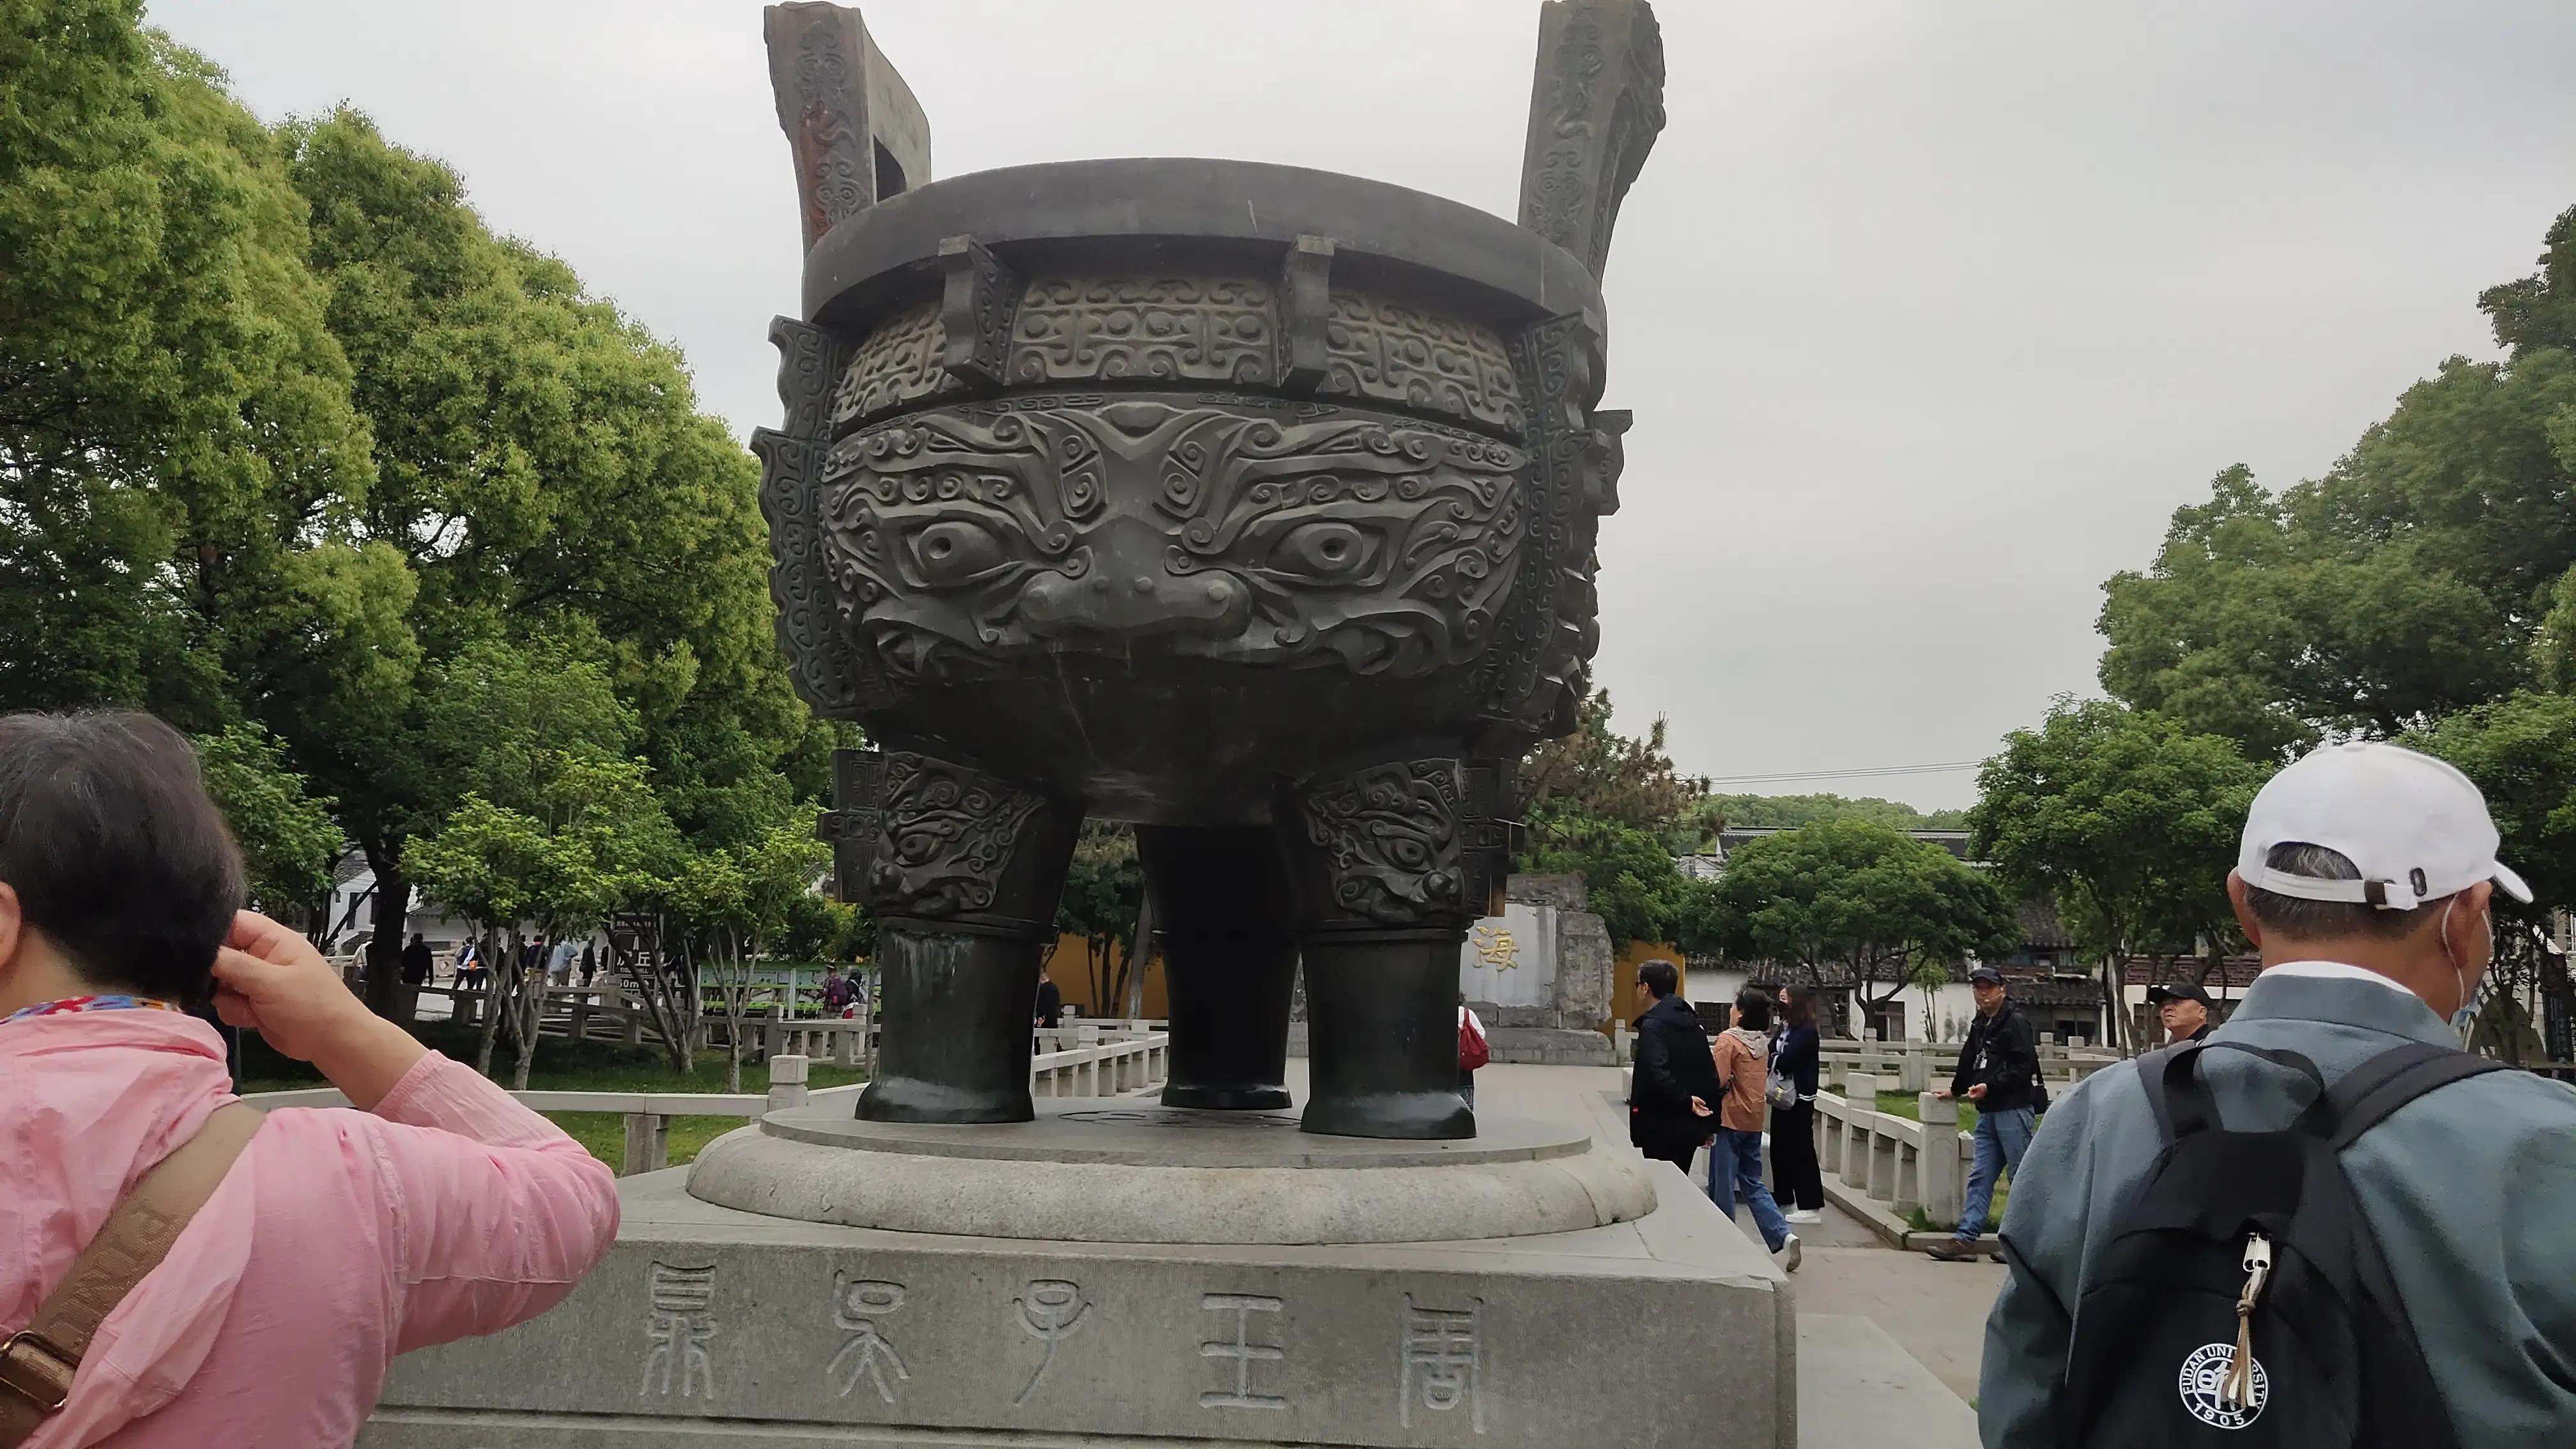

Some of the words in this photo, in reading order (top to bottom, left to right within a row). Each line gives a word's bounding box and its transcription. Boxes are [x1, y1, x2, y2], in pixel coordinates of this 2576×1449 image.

[1472, 926, 1520, 971] 海
[2183, 1351, 2205, 1395] FUDAN
[2206, 1347, 2265, 1409] UNIRSITY
[2193, 1402, 2244, 1425] 1905
